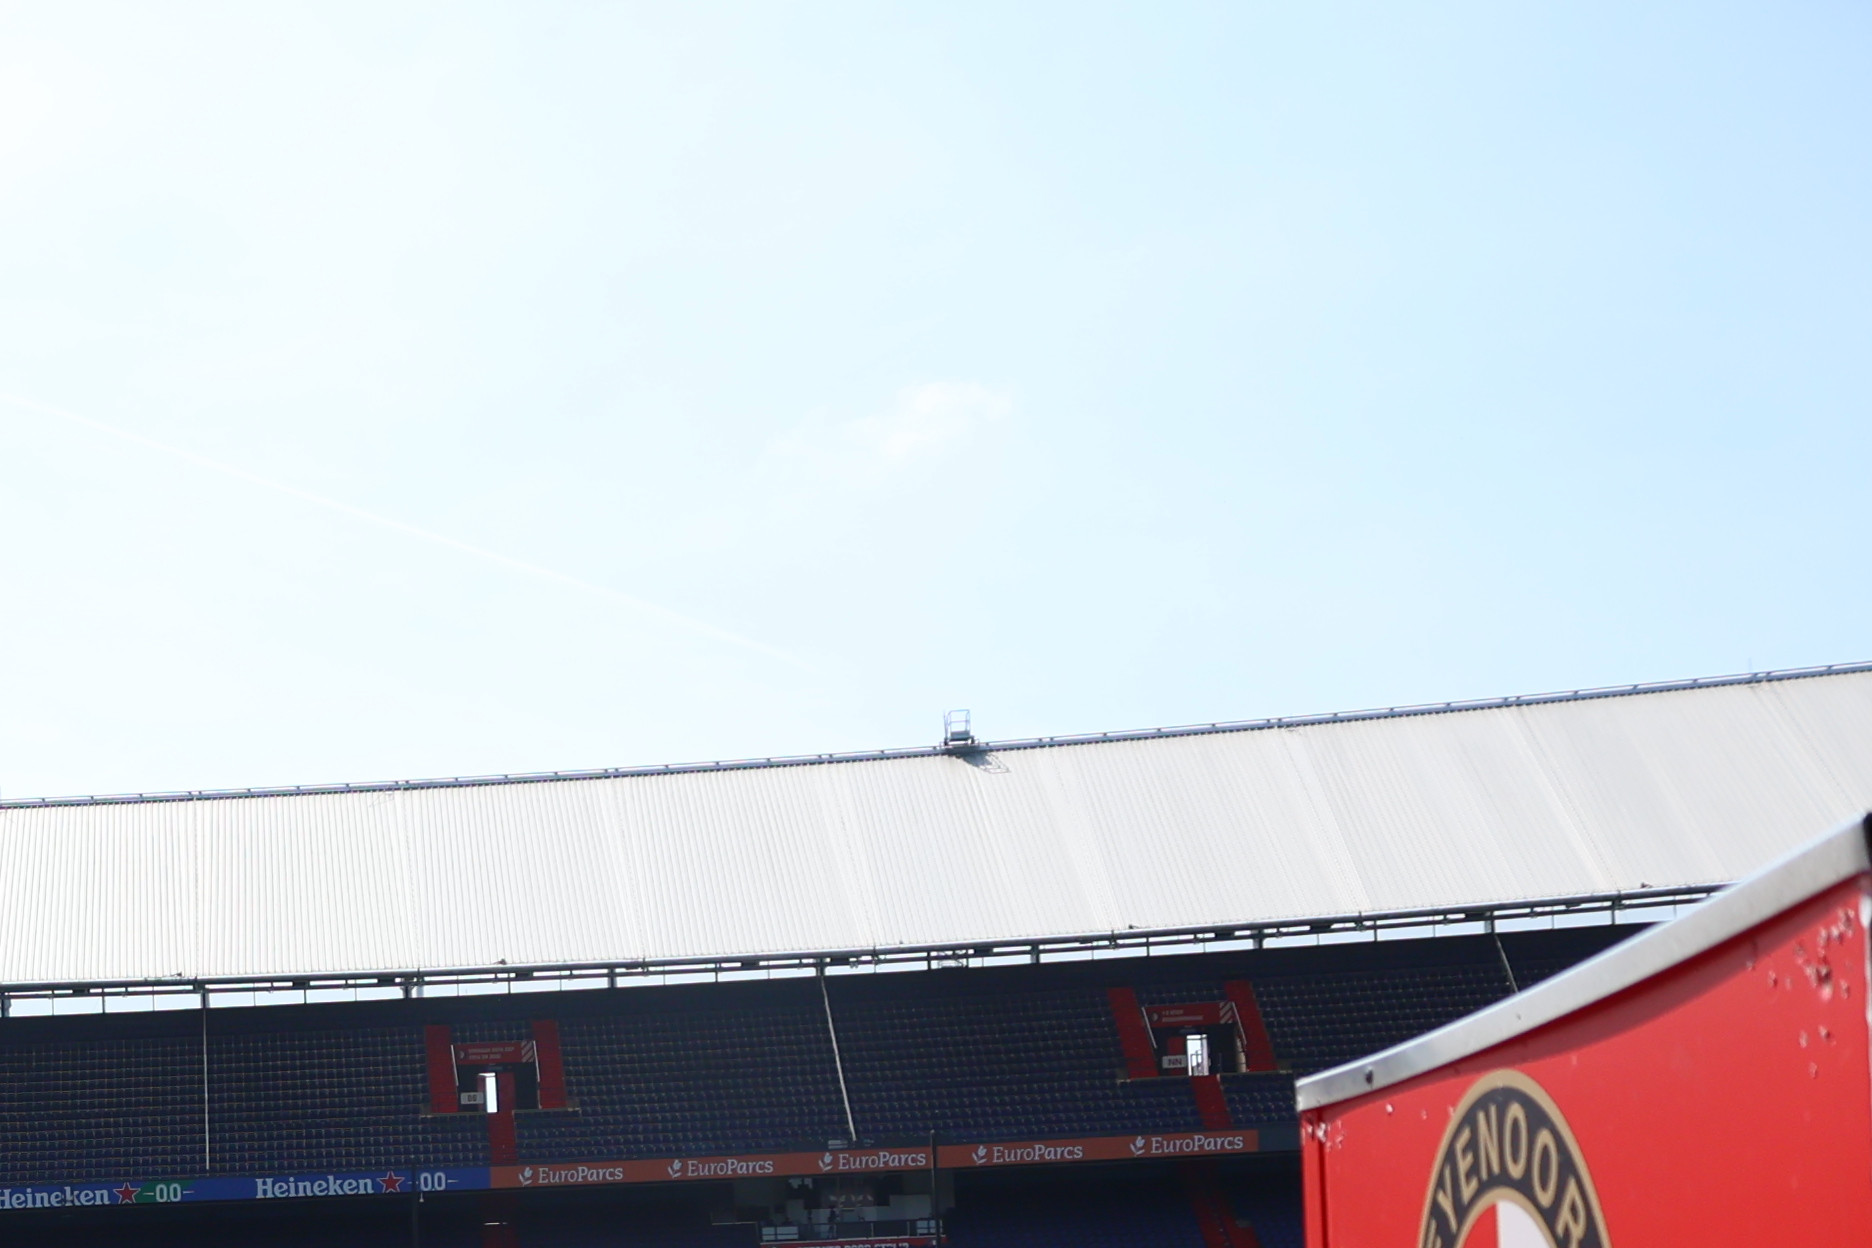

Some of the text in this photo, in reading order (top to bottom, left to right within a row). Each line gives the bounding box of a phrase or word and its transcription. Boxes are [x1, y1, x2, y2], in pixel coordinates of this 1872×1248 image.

[992, 1144, 1084, 1164] EuroParcs
[1150, 1135, 1245, 1154] EuroParcs
[687, 1159, 774, 1177] EuroParcs
[838, 1151, 926, 1171] EuroParcs
[538, 1166, 624, 1185] EuroParcs
[255, 1174, 374, 1199] Heineken
